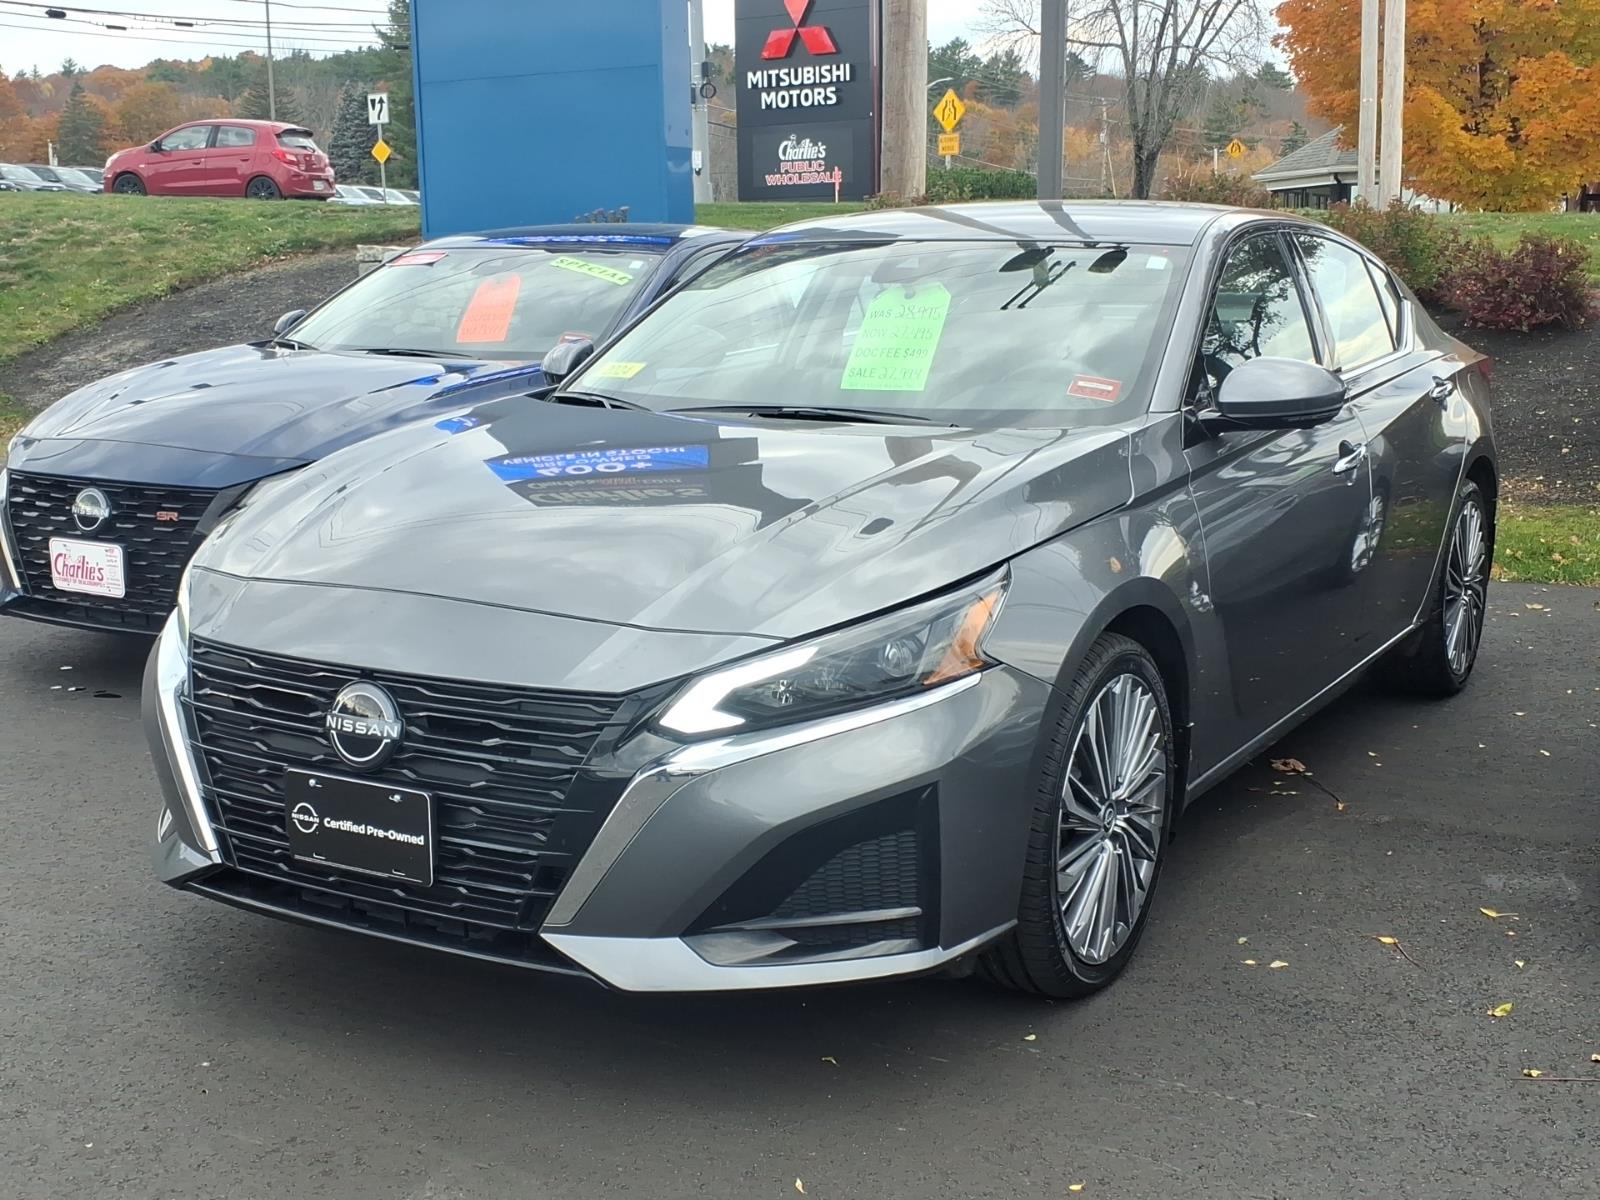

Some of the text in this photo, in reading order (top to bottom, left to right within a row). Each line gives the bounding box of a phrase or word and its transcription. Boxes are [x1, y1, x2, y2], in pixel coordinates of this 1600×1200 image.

[747, 63, 850, 89] MITSUBISHI
[760, 86, 837, 110] MOTORS
[778, 138, 827, 161] Charlie's
[780, 160, 825, 173] PUBLIC
[557, 257, 630, 284] SPECIAL
[870, 308, 893, 319] WAS
[848, 367, 877, 379] SALE
[156, 511, 179, 522] SR
[54, 552, 105, 582] Charlie's
[326, 714, 398, 738] NISSAN
[291, 812, 425, 846] NISSAN Certified Pre-Owned
